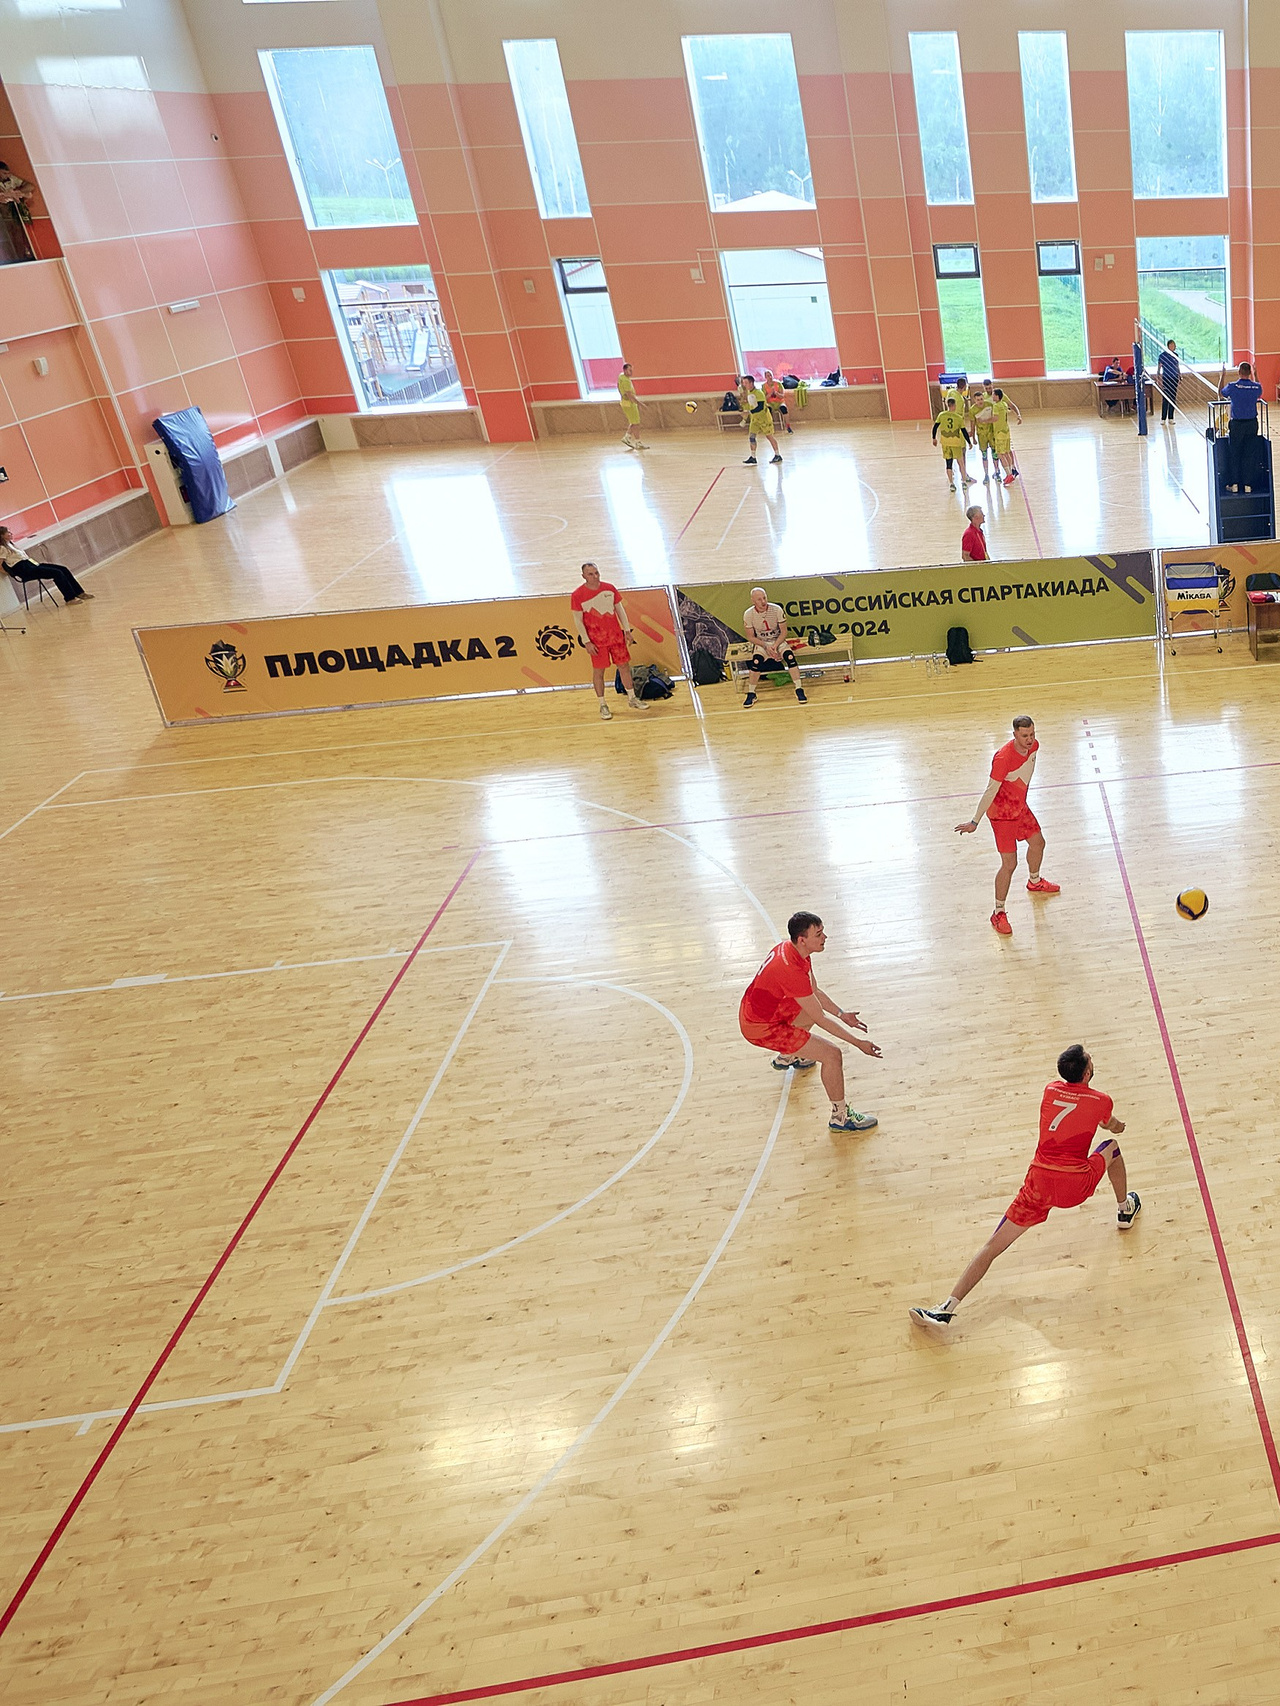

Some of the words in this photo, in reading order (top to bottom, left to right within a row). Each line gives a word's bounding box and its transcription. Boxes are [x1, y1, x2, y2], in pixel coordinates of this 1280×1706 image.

[946, 418, 954, 429] 3
[957, 577, 1110, 604] СПАРТАКИАДА
[763, 619, 771, 631] 1
[838, 620, 890, 638] 2024
[264, 638, 492, 678] ПЛОЩАДКА
[495, 635, 518, 658] 2
[1048, 1099, 1078, 1132] 7
